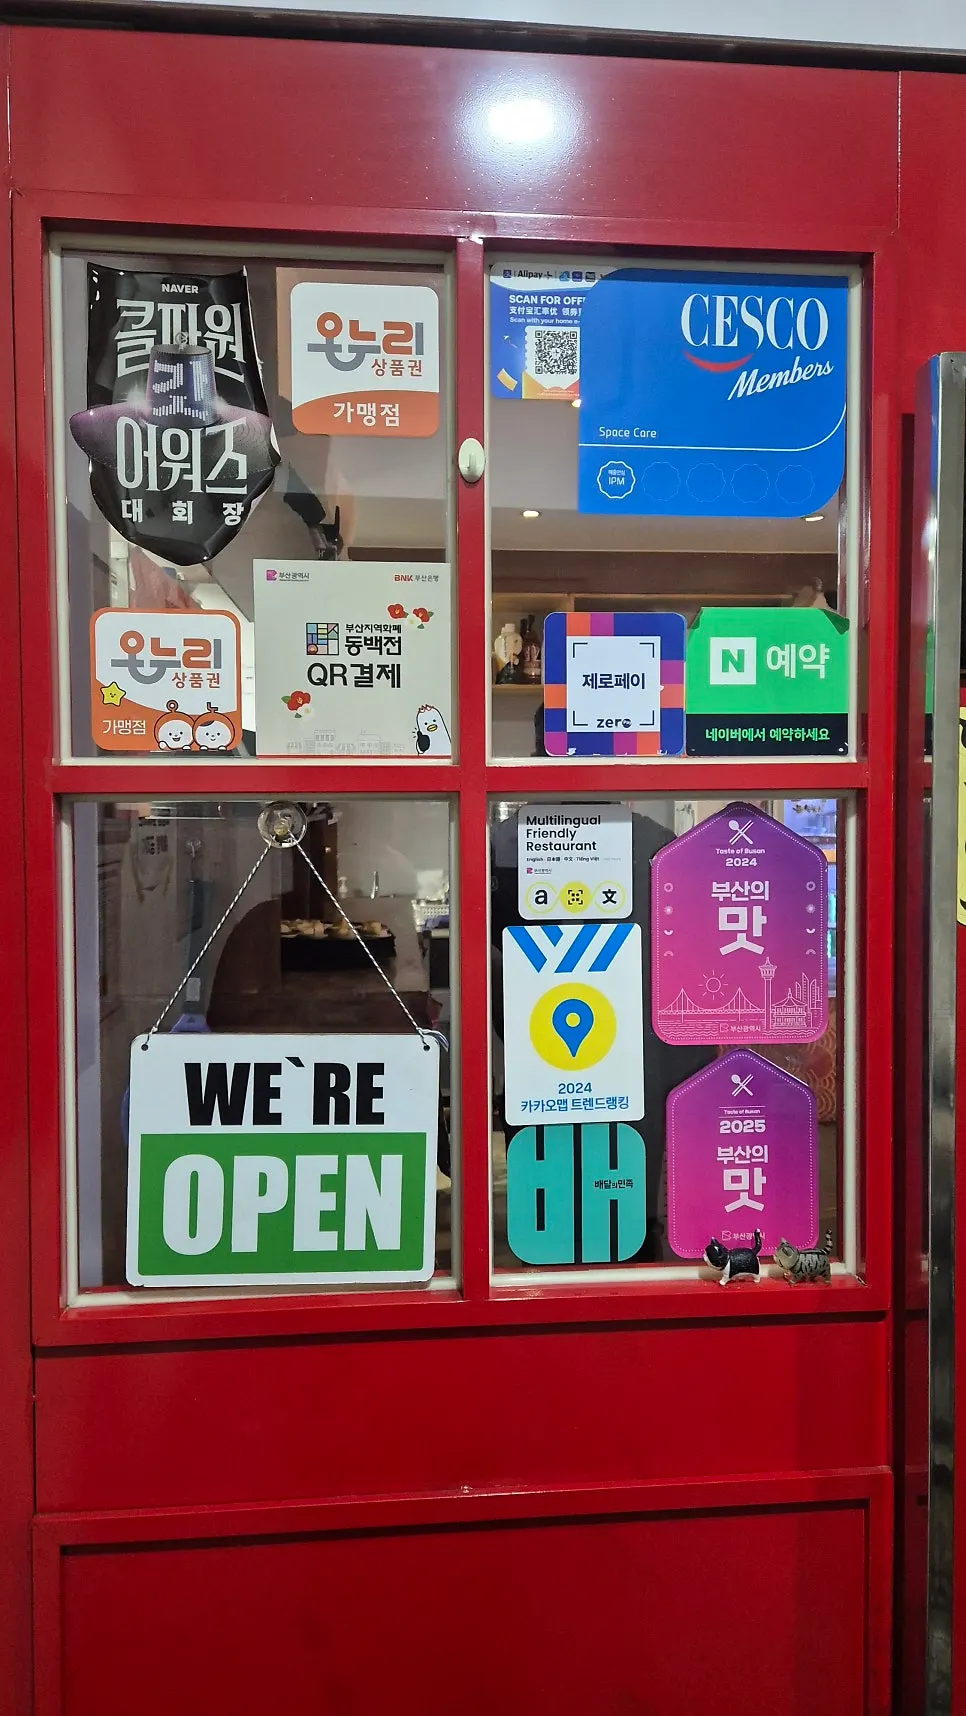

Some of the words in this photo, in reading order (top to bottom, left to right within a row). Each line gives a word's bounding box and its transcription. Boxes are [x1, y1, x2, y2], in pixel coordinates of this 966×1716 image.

[161, 283, 199, 294] NAVER
[508, 295, 538, 303] SCAN
[541, 296, 561, 304] FOR
[563, 296, 586, 305] OFF
[681, 293, 829, 351] CESCO
[371, 358, 423, 377] 상품권
[727, 356, 835, 401] Members
[333, 402, 401, 428] 가맹점
[598, 426, 630, 439] Space
[633, 427, 657, 438] Care
[116, 416, 248, 495] 어워즈
[608, 476, 625, 486] IPM
[279, 571, 310, 579] 부산광역시
[394, 574, 413, 582] BNK
[345, 623, 402, 634] 부산지역화폐
[344, 635, 402, 656] 동백전
[721, 648, 745, 673] N
[766, 643, 831, 679] 예약
[171, 671, 221, 689] 상품권
[581, 672, 646, 690] 제로페이
[102, 719, 146, 735] 가맹점
[705, 727, 766, 742] 네이버에서
[769, 727, 831, 742] 예약하세요
[526, 815, 601, 828] Multilingual
[526, 828, 577, 841] Friendly
[526, 841, 597, 851] Restaurant
[725, 857, 758, 867] 2024
[711, 881, 770, 901] 부산의
[718, 905, 768, 956] 맛
[730, 1025, 761, 1033] 부산광역시
[558, 1082, 592, 1094] 2024
[520, 1098, 568, 1113] 카카오맵
[570, 1096, 629, 1111] 트렌드랭킹
[719, 1119, 766, 1134] 2025
[716, 1145, 769, 1165] 부산의
[594, 1179, 634, 1189] 배달의민족
[723, 1167, 767, 1213] 맛
[162, 1154, 404, 1256] OPEN
